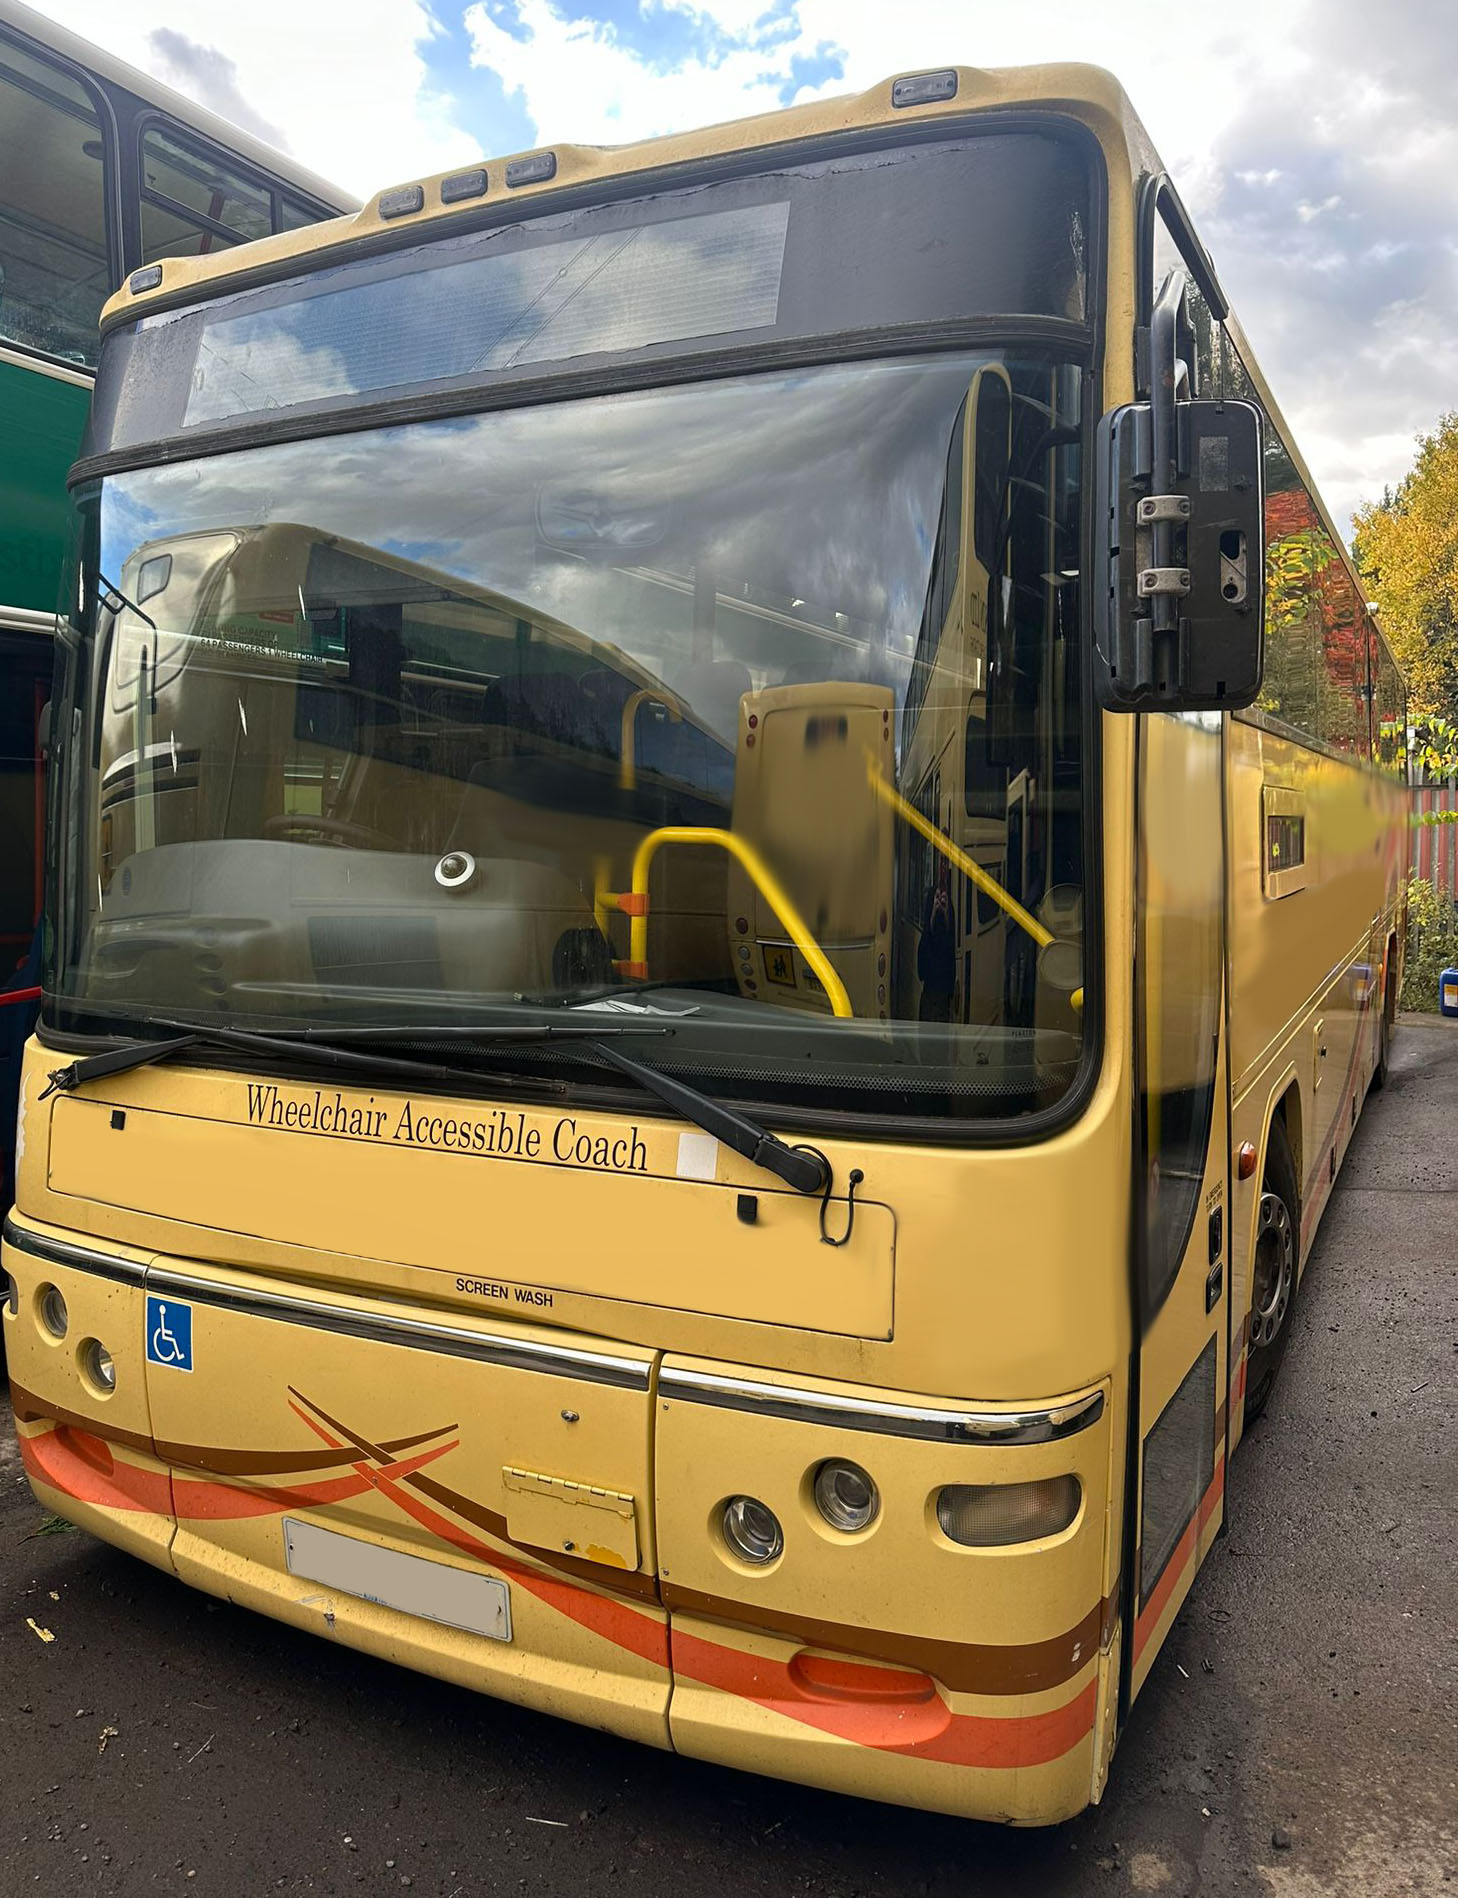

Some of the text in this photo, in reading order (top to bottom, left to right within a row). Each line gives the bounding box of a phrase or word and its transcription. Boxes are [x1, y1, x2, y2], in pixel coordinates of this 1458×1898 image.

[213, 640, 266, 655] PASSENGERS
[274, 648, 323, 663] WHEELCHAIR
[246, 1083, 648, 1171] Wheelchair Accessible Coach
[456, 1278, 554, 1308] SCREEN WASH
